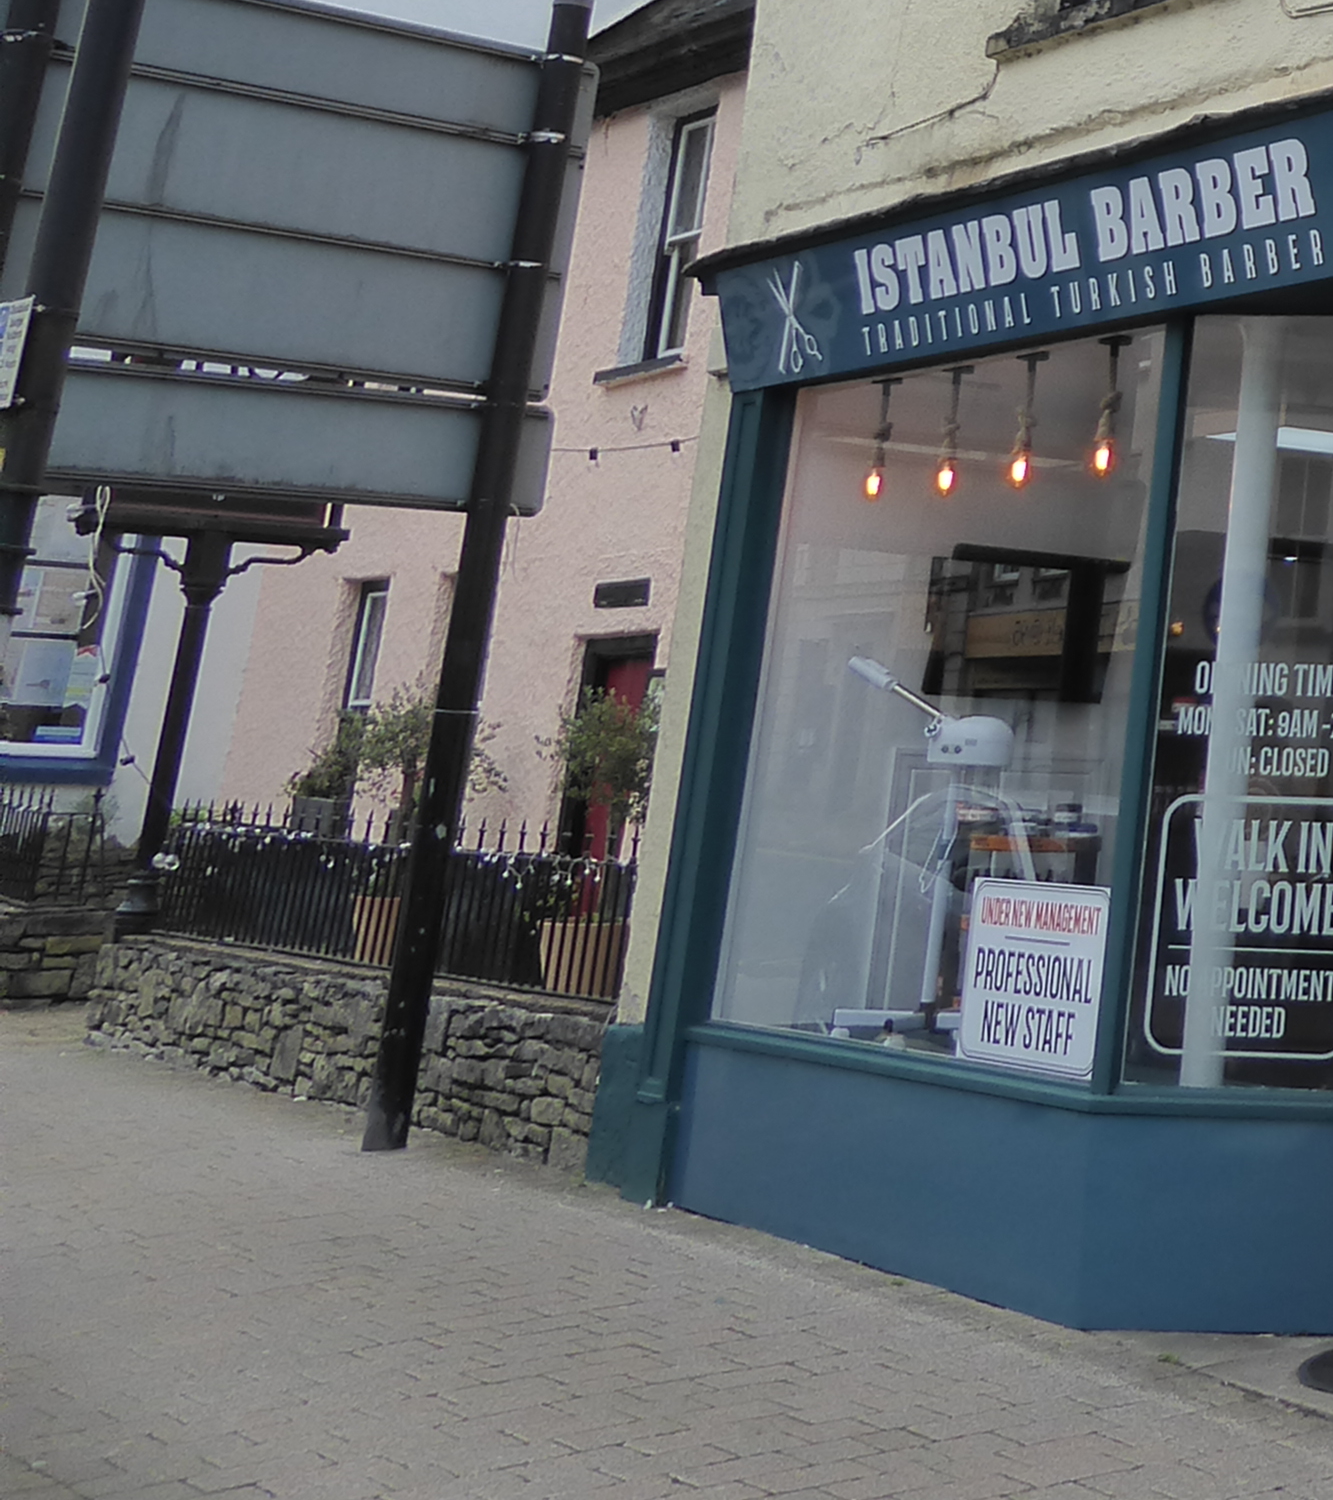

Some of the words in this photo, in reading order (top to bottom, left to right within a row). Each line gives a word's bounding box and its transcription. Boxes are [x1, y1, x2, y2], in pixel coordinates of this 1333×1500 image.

[854, 199, 1081, 315] ISTANBUL
[1090, 138, 1316, 262] BARBER
[861, 292, 1031, 356] TRADITIONAL
[1051, 260, 1177, 318] TURKISH
[1199, 229, 1324, 288] BARBER
[1194, 661, 1289, 696] ONING
[1277, 709, 1319, 738] 9AM
[1259, 746, 1330, 777] CLOSED
[981, 896, 1012, 927] UNDER
[1011, 898, 1035, 929] NEW
[1034, 900, 1102, 936] MANAGEMENT
[973, 946, 1093, 1004] PROFESSIONAL
[980, 999, 1022, 1047] NEW
[1023, 1005, 1076, 1056] STAFF
[1210, 1005, 1286, 1038] NEEDED
